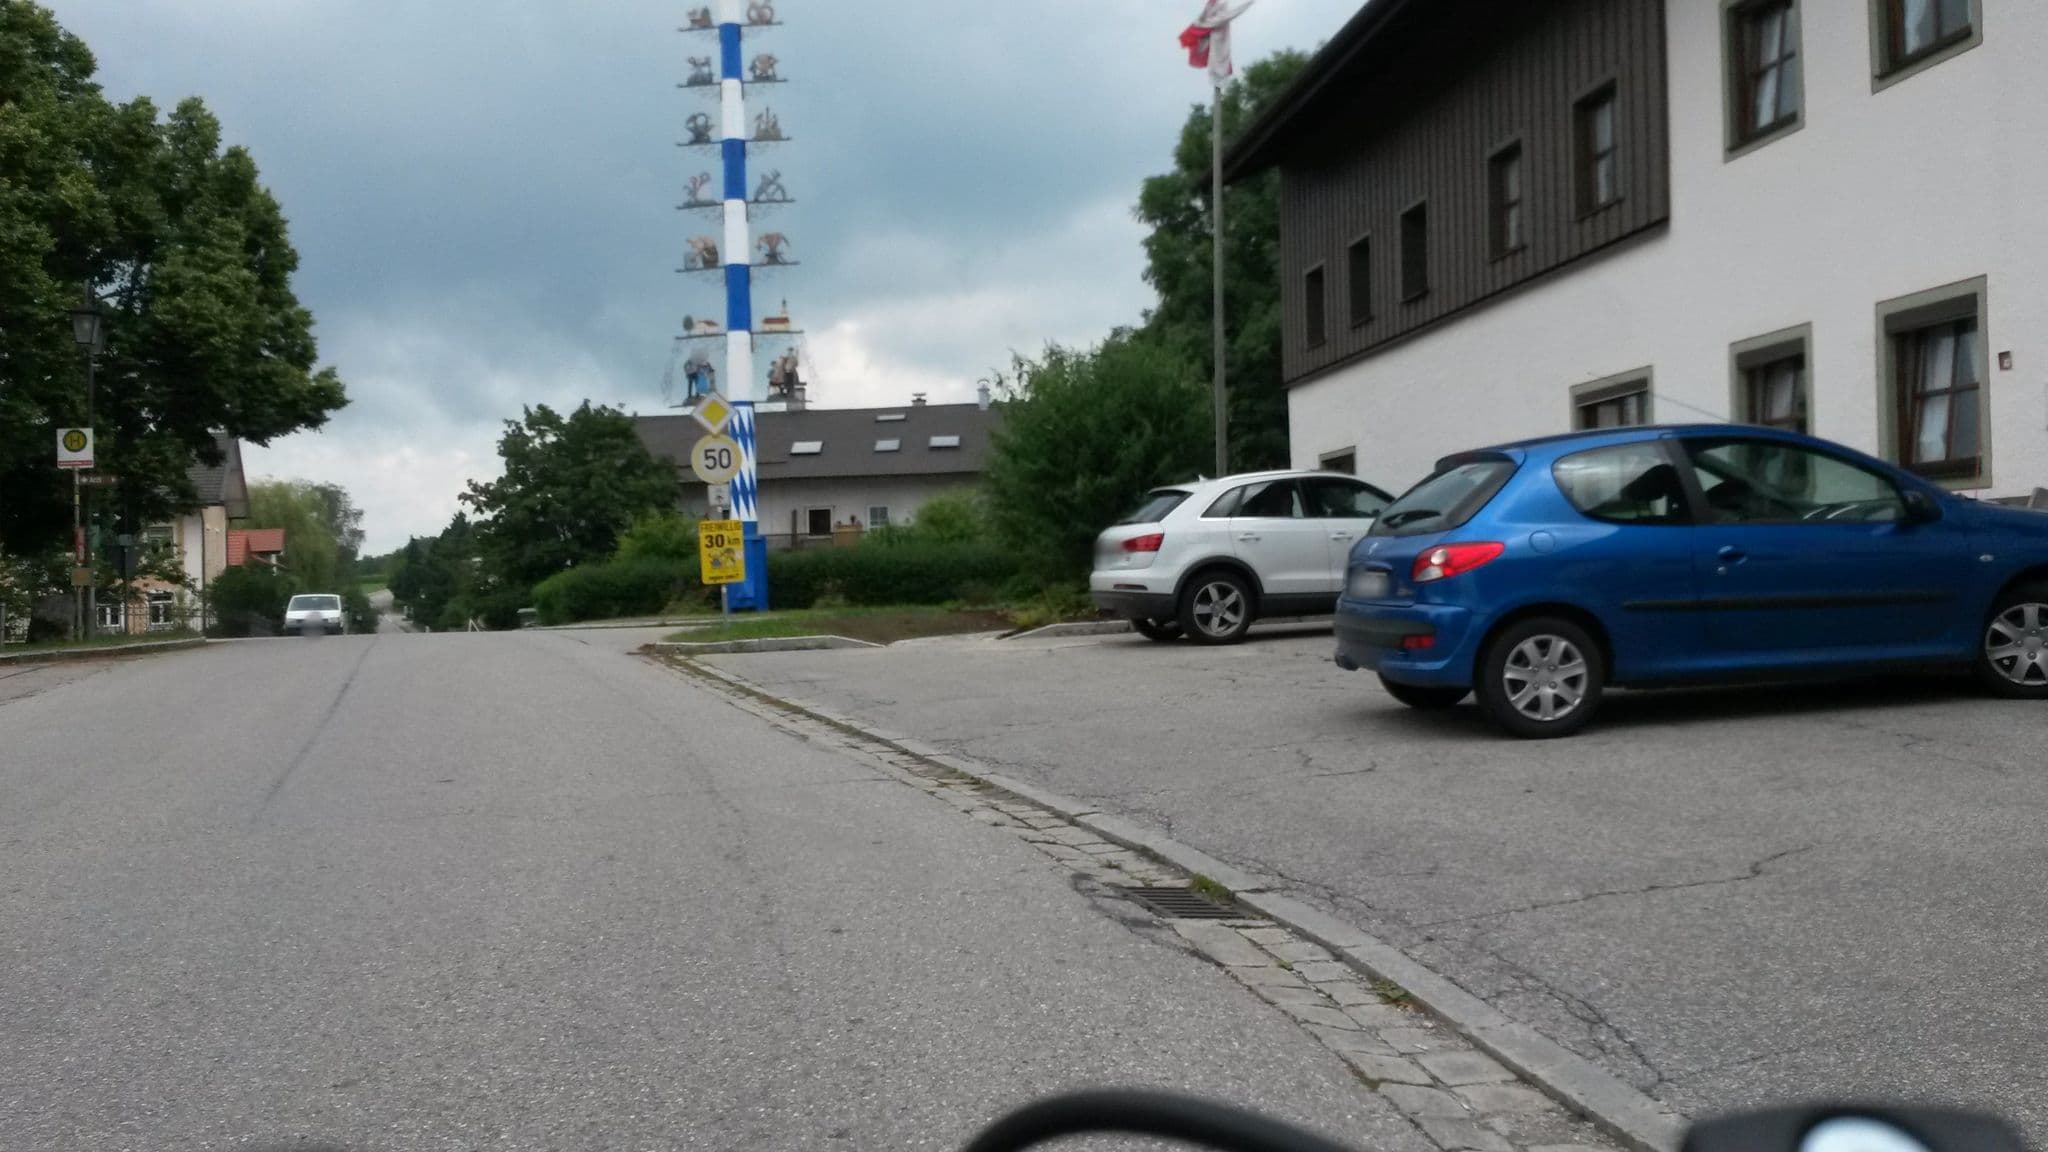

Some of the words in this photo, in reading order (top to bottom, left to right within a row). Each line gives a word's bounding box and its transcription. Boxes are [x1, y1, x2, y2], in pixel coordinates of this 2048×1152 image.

[70, 434, 80, 447] H
[704, 448, 731, 470] 50
[705, 534, 724, 548] 30
